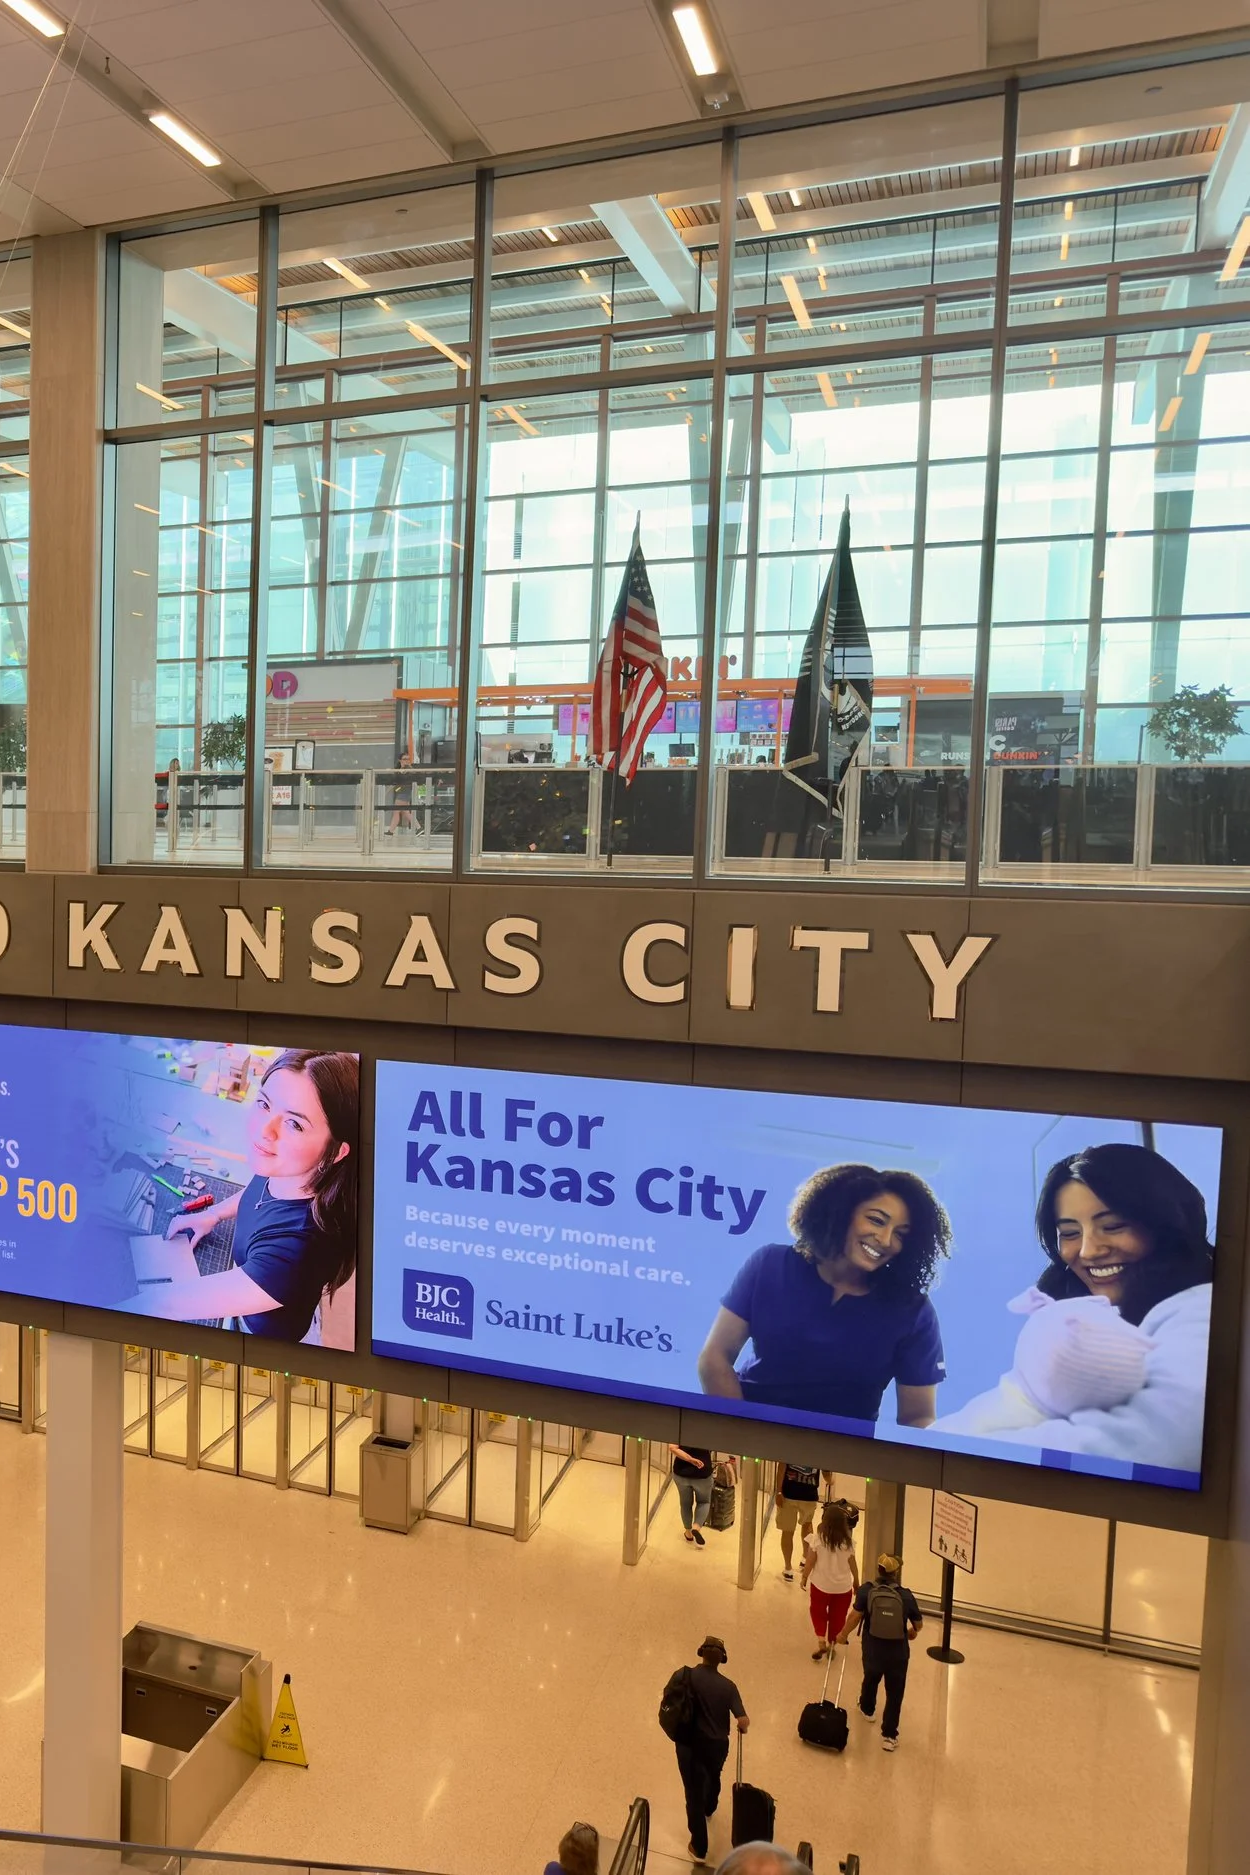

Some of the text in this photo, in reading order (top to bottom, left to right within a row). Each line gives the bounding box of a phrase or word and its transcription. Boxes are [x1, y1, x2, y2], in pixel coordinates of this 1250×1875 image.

[66, 900, 544, 997] KANSAS
[619, 919, 1000, 1022] CITY
[407, 1090, 605, 1150] All For
[17, 1177, 77, 1223] 500
[405, 1141, 767, 1235] Kansas City
[9, 1240, 17, 1248] in
[405, 1205, 656, 1253] Because every moment
[2, 1248, 17, 1260] list.
[404, 1231, 691, 1286] deserves exceptional care.
[415, 1282, 461, 1309] BJC
[415, 1307, 460, 1325] Health
[485, 1299, 674, 1353] Saint Luke's
